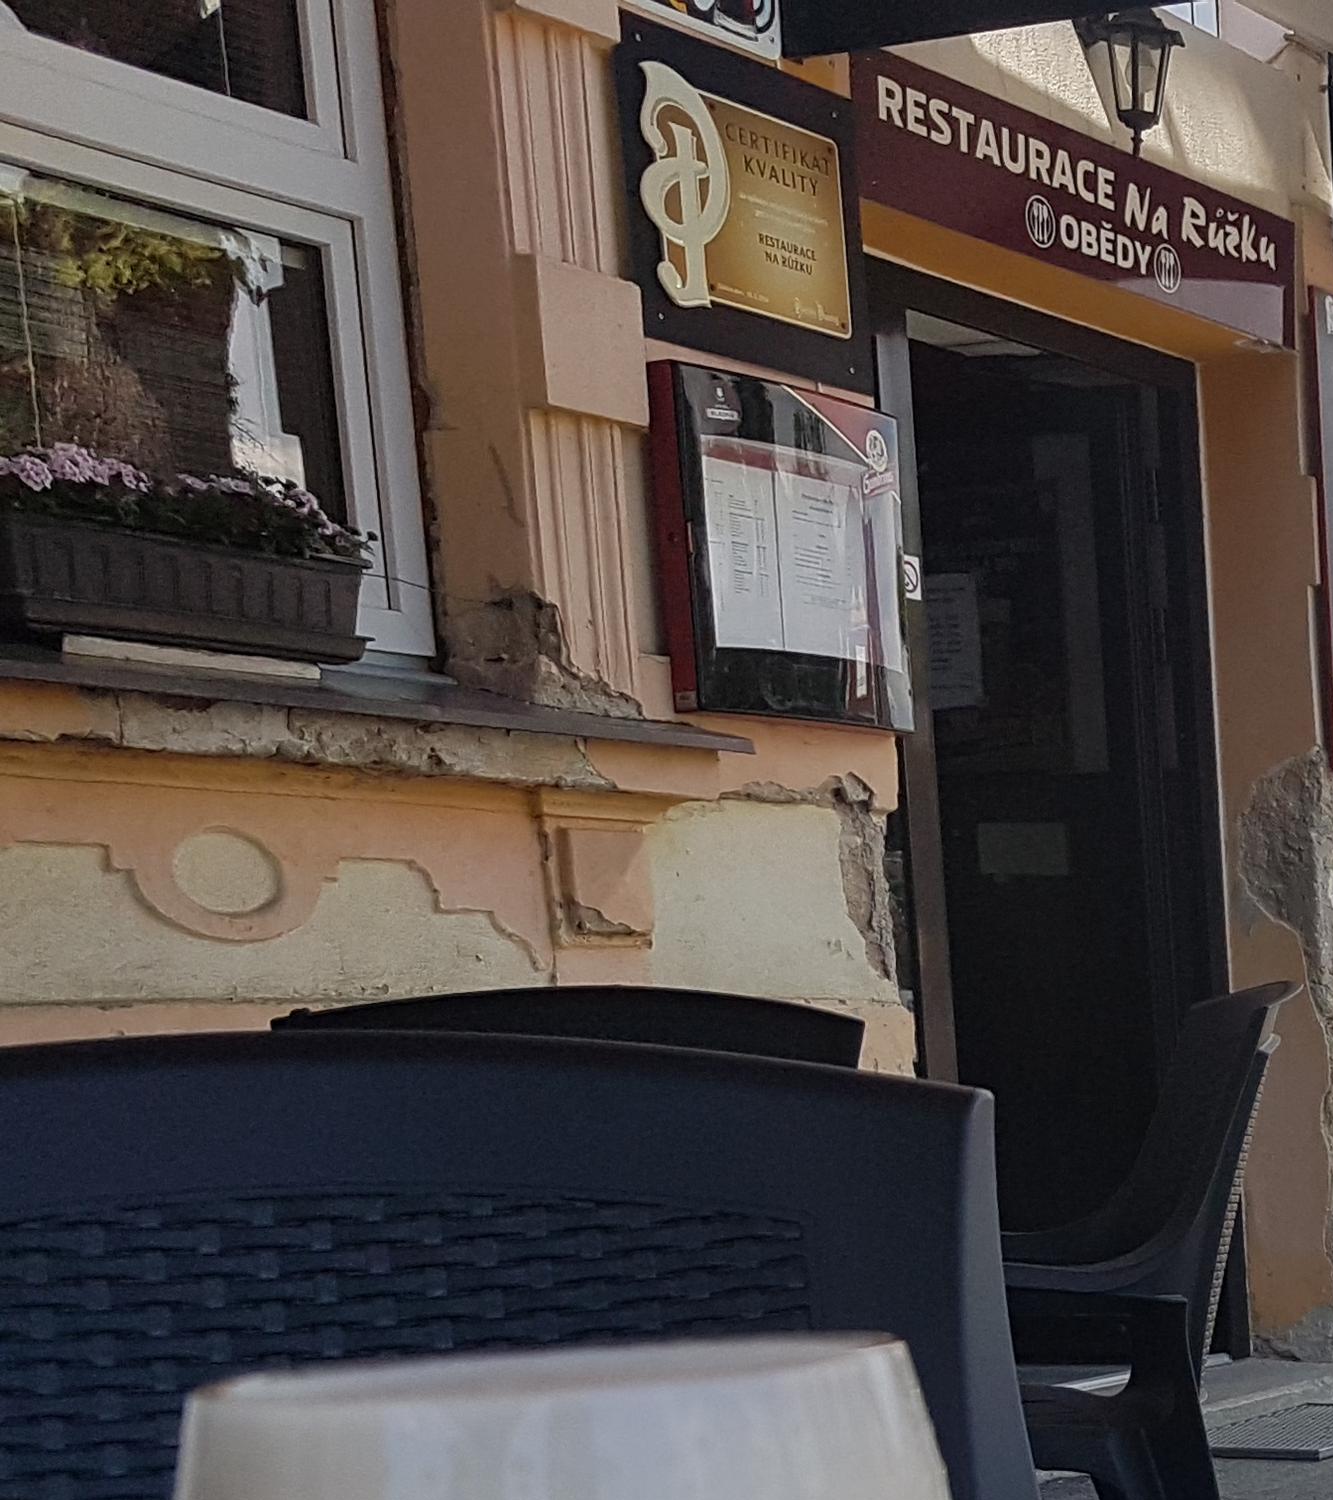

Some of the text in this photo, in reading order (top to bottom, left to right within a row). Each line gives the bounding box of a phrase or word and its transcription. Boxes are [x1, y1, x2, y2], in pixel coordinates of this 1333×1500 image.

[743, 154, 818, 197] KVALITY
[877, 75, 1116, 212] RESTAURACE
[1124, 182, 1169, 240] Na
[1181, 196, 1277, 271] Růžku
[758, 233, 817, 262] RESTAURACE
[764, 251, 779, 265] NA
[1060, 214, 1153, 276] OBĚDY
